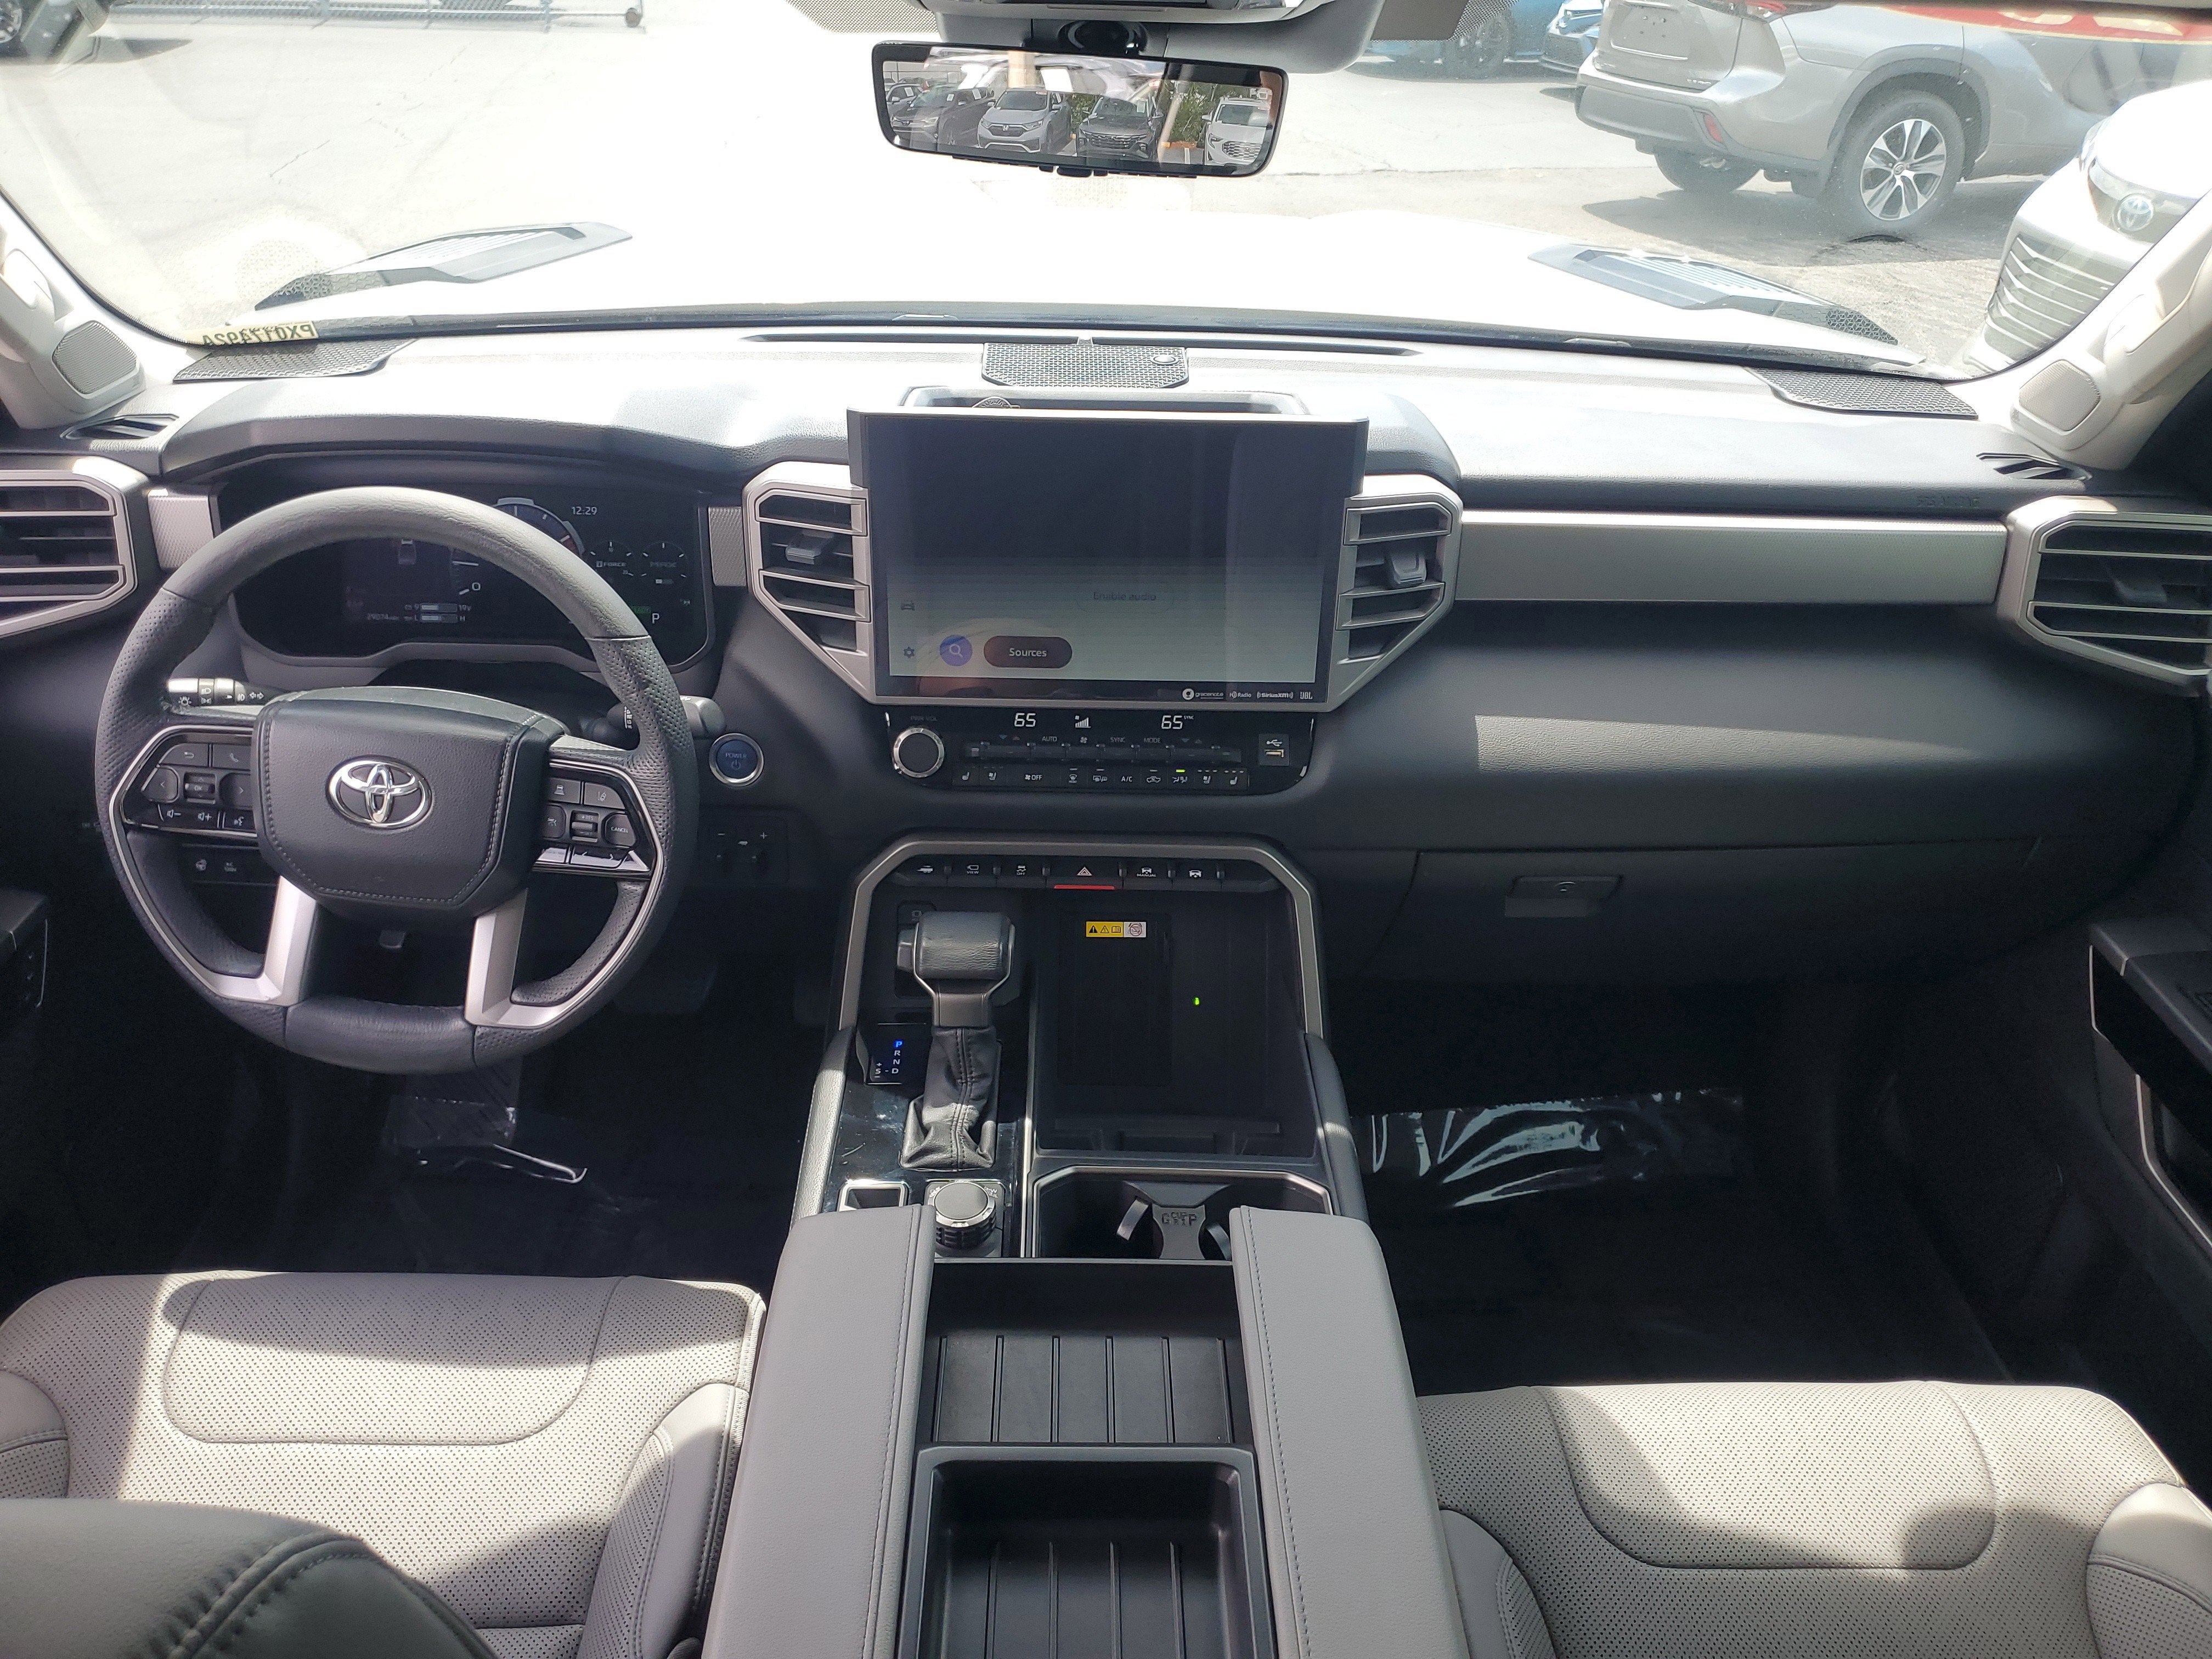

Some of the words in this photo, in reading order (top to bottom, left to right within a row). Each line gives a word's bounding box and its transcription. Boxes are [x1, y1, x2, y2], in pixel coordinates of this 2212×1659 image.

[571, 506, 597, 515] 12:29
[1093, 592, 1126, 601] Enable
[1128, 592, 1156, 601] audio
[652, 613, 659, 624] P
[1009, 648, 1047, 657] Sources
[1300, 691, 1313, 699] JBL
[1014, 713, 1036, 727] 65
[1161, 715, 1183, 730] 65
